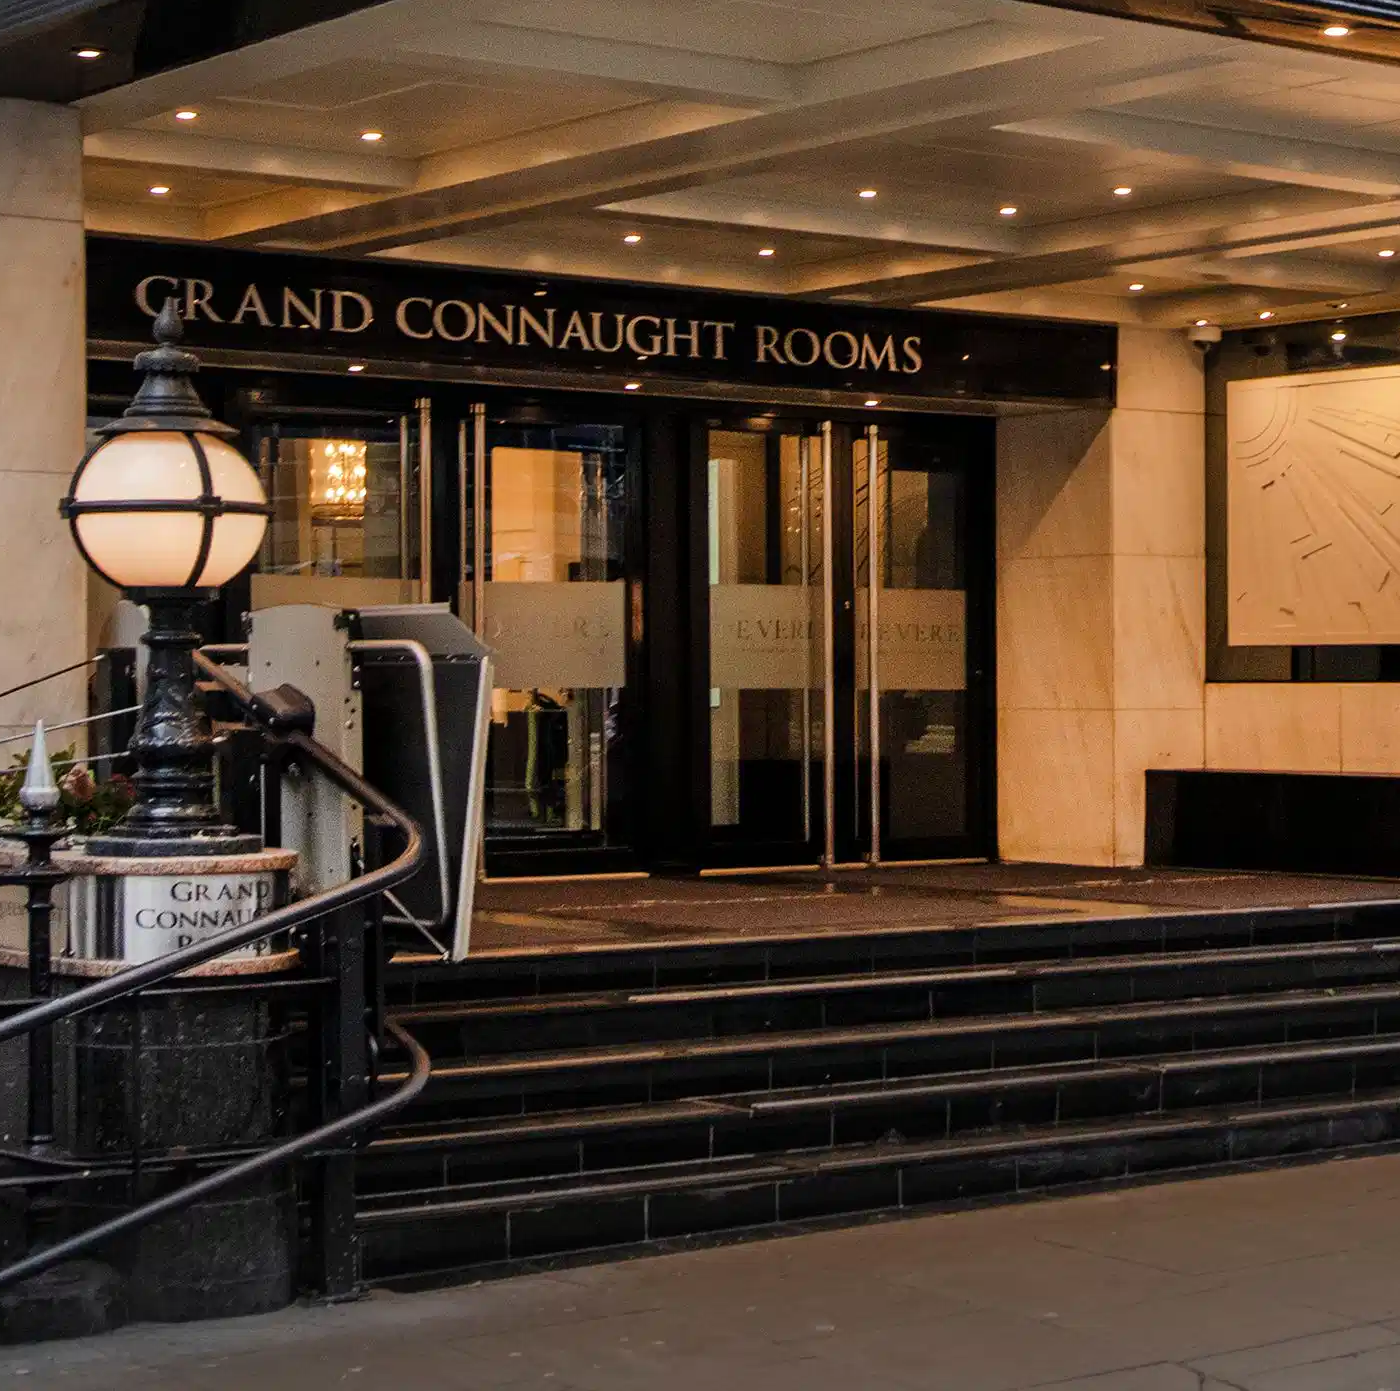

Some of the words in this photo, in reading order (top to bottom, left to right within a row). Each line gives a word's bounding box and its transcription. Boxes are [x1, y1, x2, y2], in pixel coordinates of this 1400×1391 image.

[134, 275, 374, 334] GRAND
[396, 297, 735, 361] CONNAUGHT
[754, 324, 923, 375] ROOMS
[170, 881, 271, 902] GRAND
